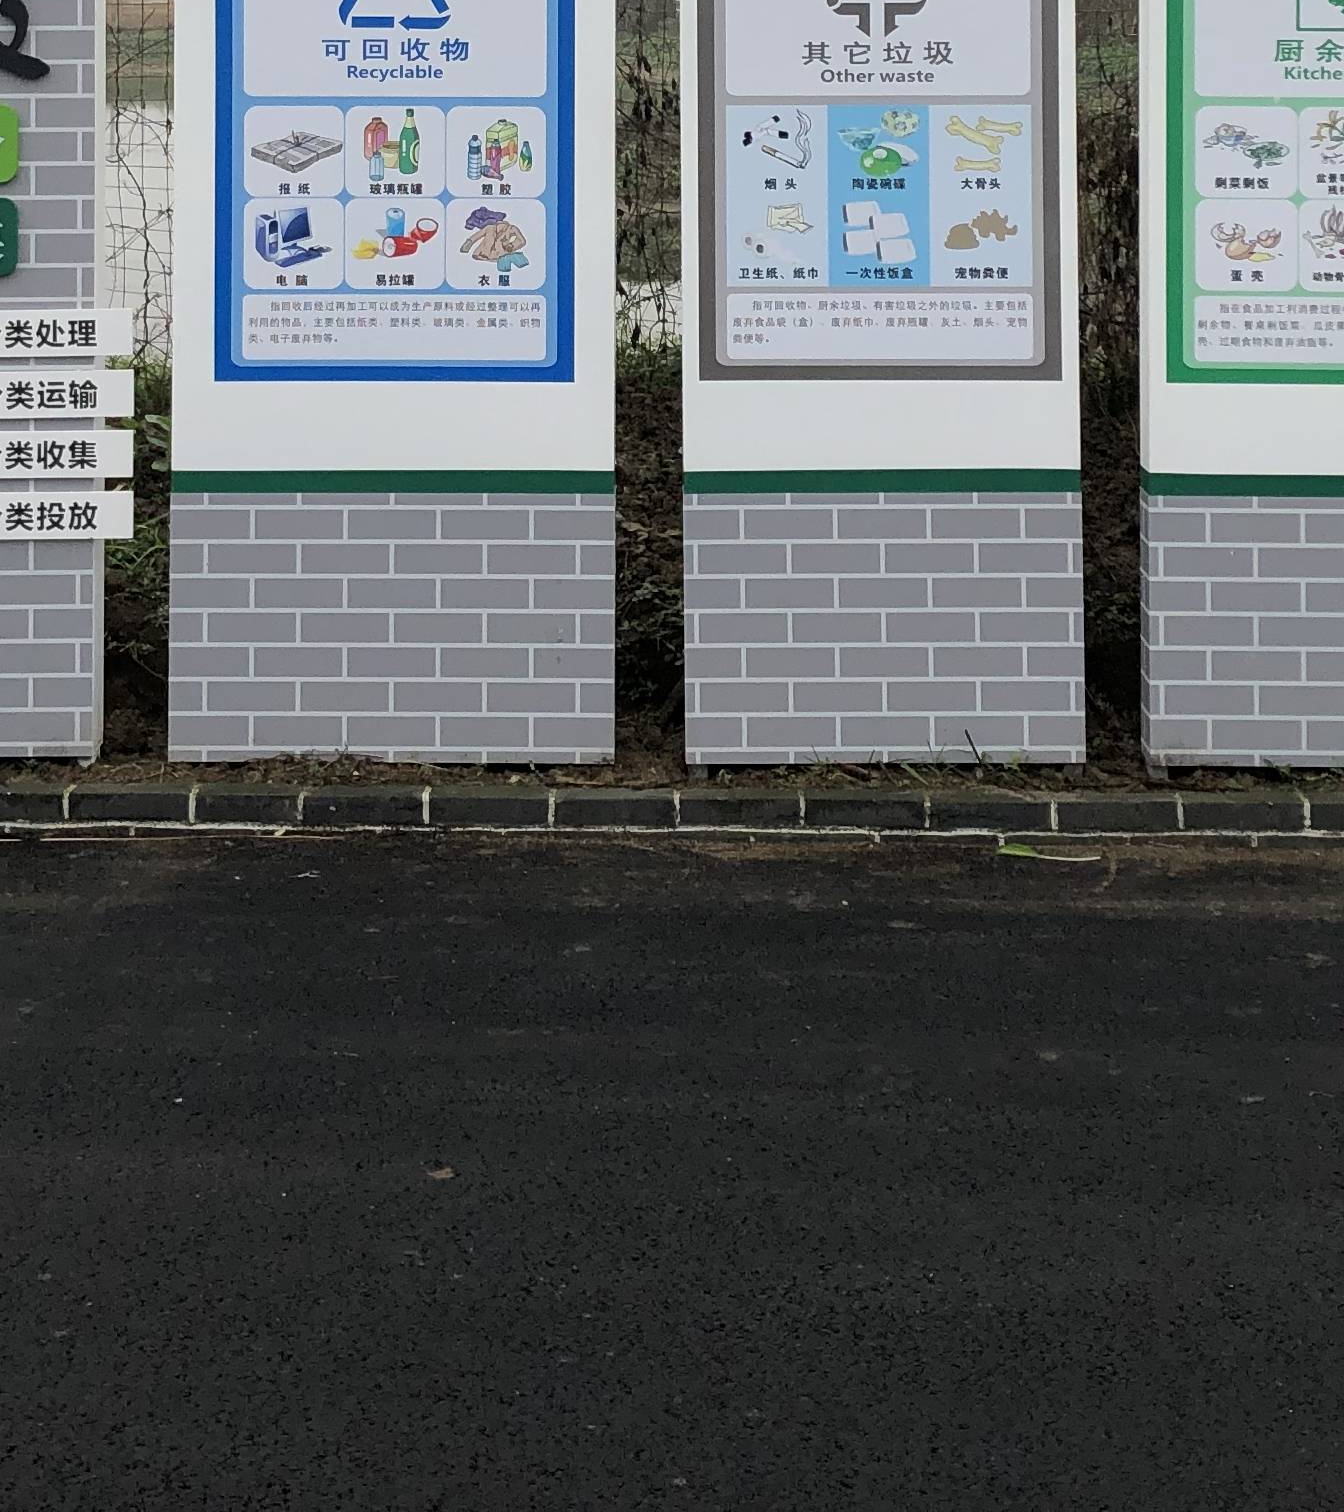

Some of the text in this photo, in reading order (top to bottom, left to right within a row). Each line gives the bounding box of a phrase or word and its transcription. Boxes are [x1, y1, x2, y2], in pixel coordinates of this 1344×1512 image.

[321, 37, 470, 62] 可回收物
[801, 40, 954, 66] 其它垃圾
[346, 64, 444, 82] Recyclable
[820, 68, 935, 83] Other waste
[278, 182, 312, 196] 报纸
[369, 182, 424, 196] 玻璃瓶罐
[481, 182, 513, 196] 塑胶
[764, 177, 797, 191] 烟头
[960, 177, 1001, 191] 大骨头
[375, 273, 416, 287] 易拉罐
[738, 266, 819, 280] 卫生纸、纸巾
[845, 266, 914, 280] 一次性饭盒
[954, 266, 1009, 280] 宠物粪便
[1230, 269, 1264, 283] 蛋壳
[276, 274, 308, 287] 电脑
[478, 274, 512, 288] 衣服
